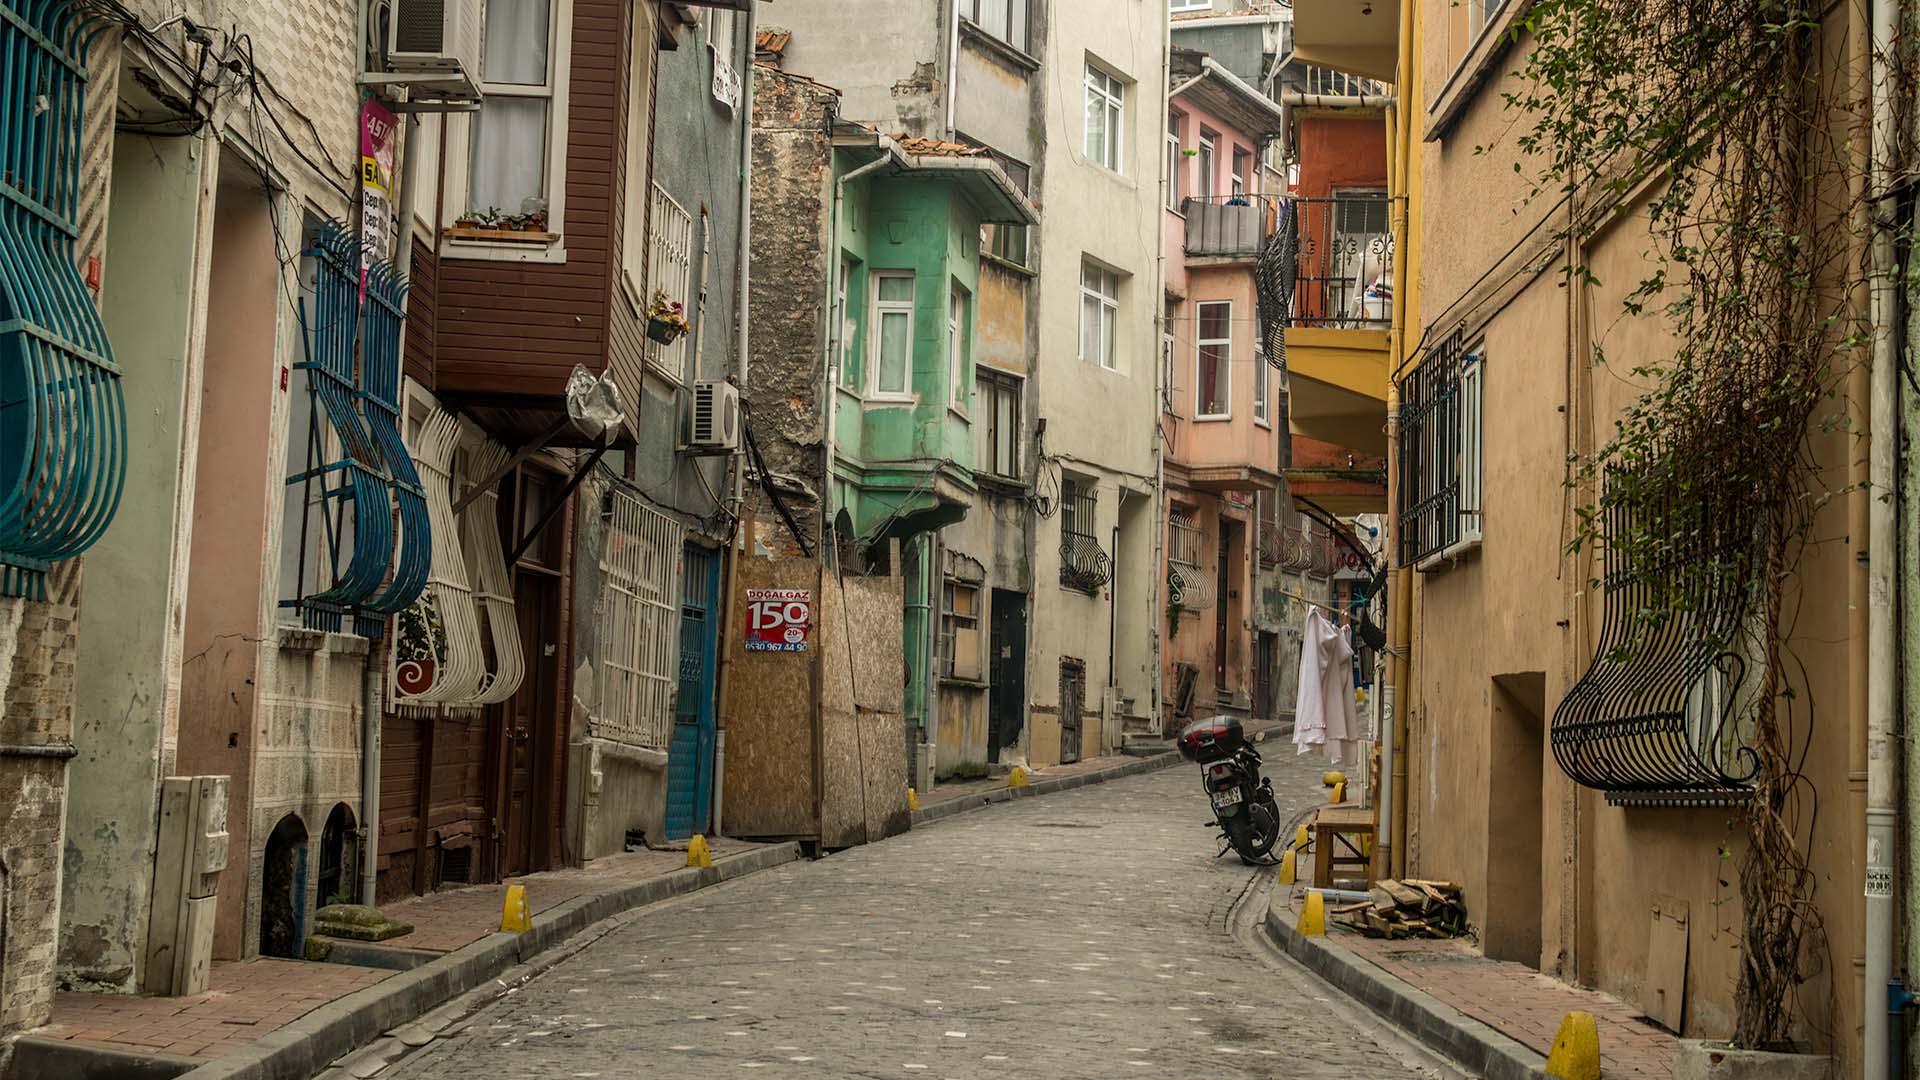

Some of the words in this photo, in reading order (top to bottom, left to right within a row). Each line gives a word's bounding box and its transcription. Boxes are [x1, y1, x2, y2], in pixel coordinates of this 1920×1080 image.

[749, 590, 809, 598] DOĞALGAZ
[748, 602, 809, 629] 150
[767, 643, 782, 651] 967
